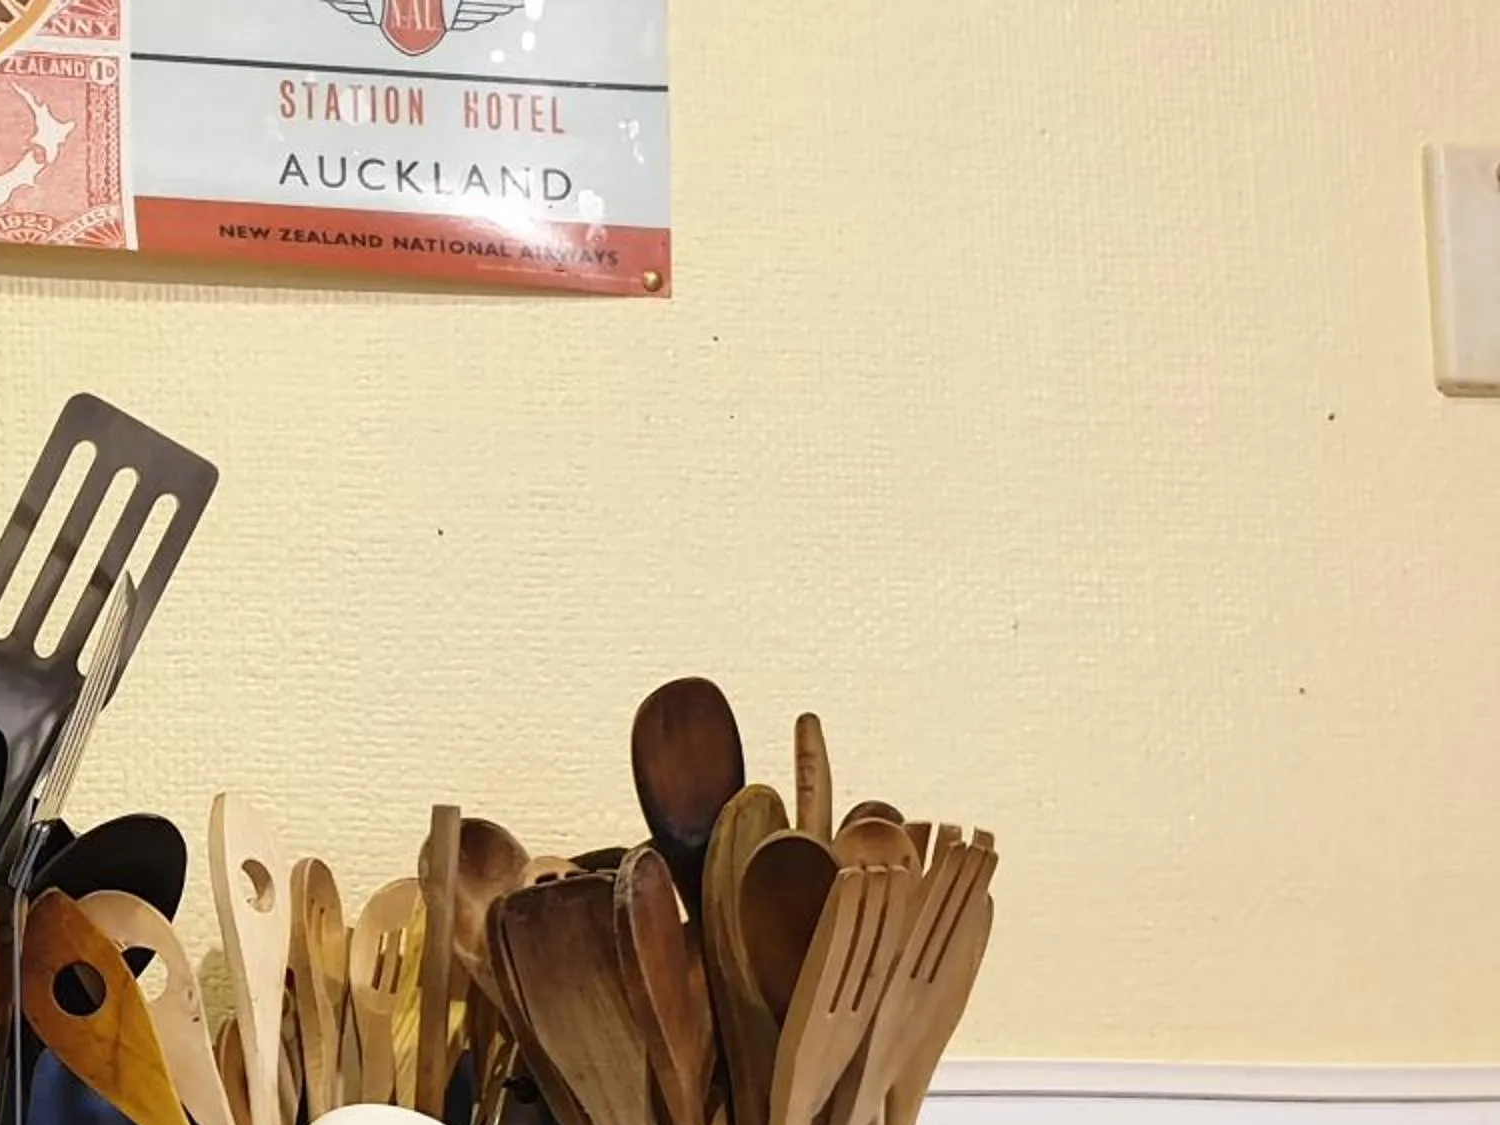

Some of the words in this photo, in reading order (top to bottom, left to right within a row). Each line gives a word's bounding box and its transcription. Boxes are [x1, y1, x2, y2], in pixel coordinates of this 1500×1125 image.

[42, 18, 118, 36] NNY
[2, 56, 86, 77] ZEALAND
[279, 79, 425, 126] STATION
[463, 90, 566, 134] HOTEL
[278, 152, 573, 202] AUCKLAND
[218, 224, 271, 241] NEW
[279, 228, 383, 249] ZEALAND
[393, 236, 512, 259] NATIONAL
[519, 244, 620, 267] AIRWAYS
